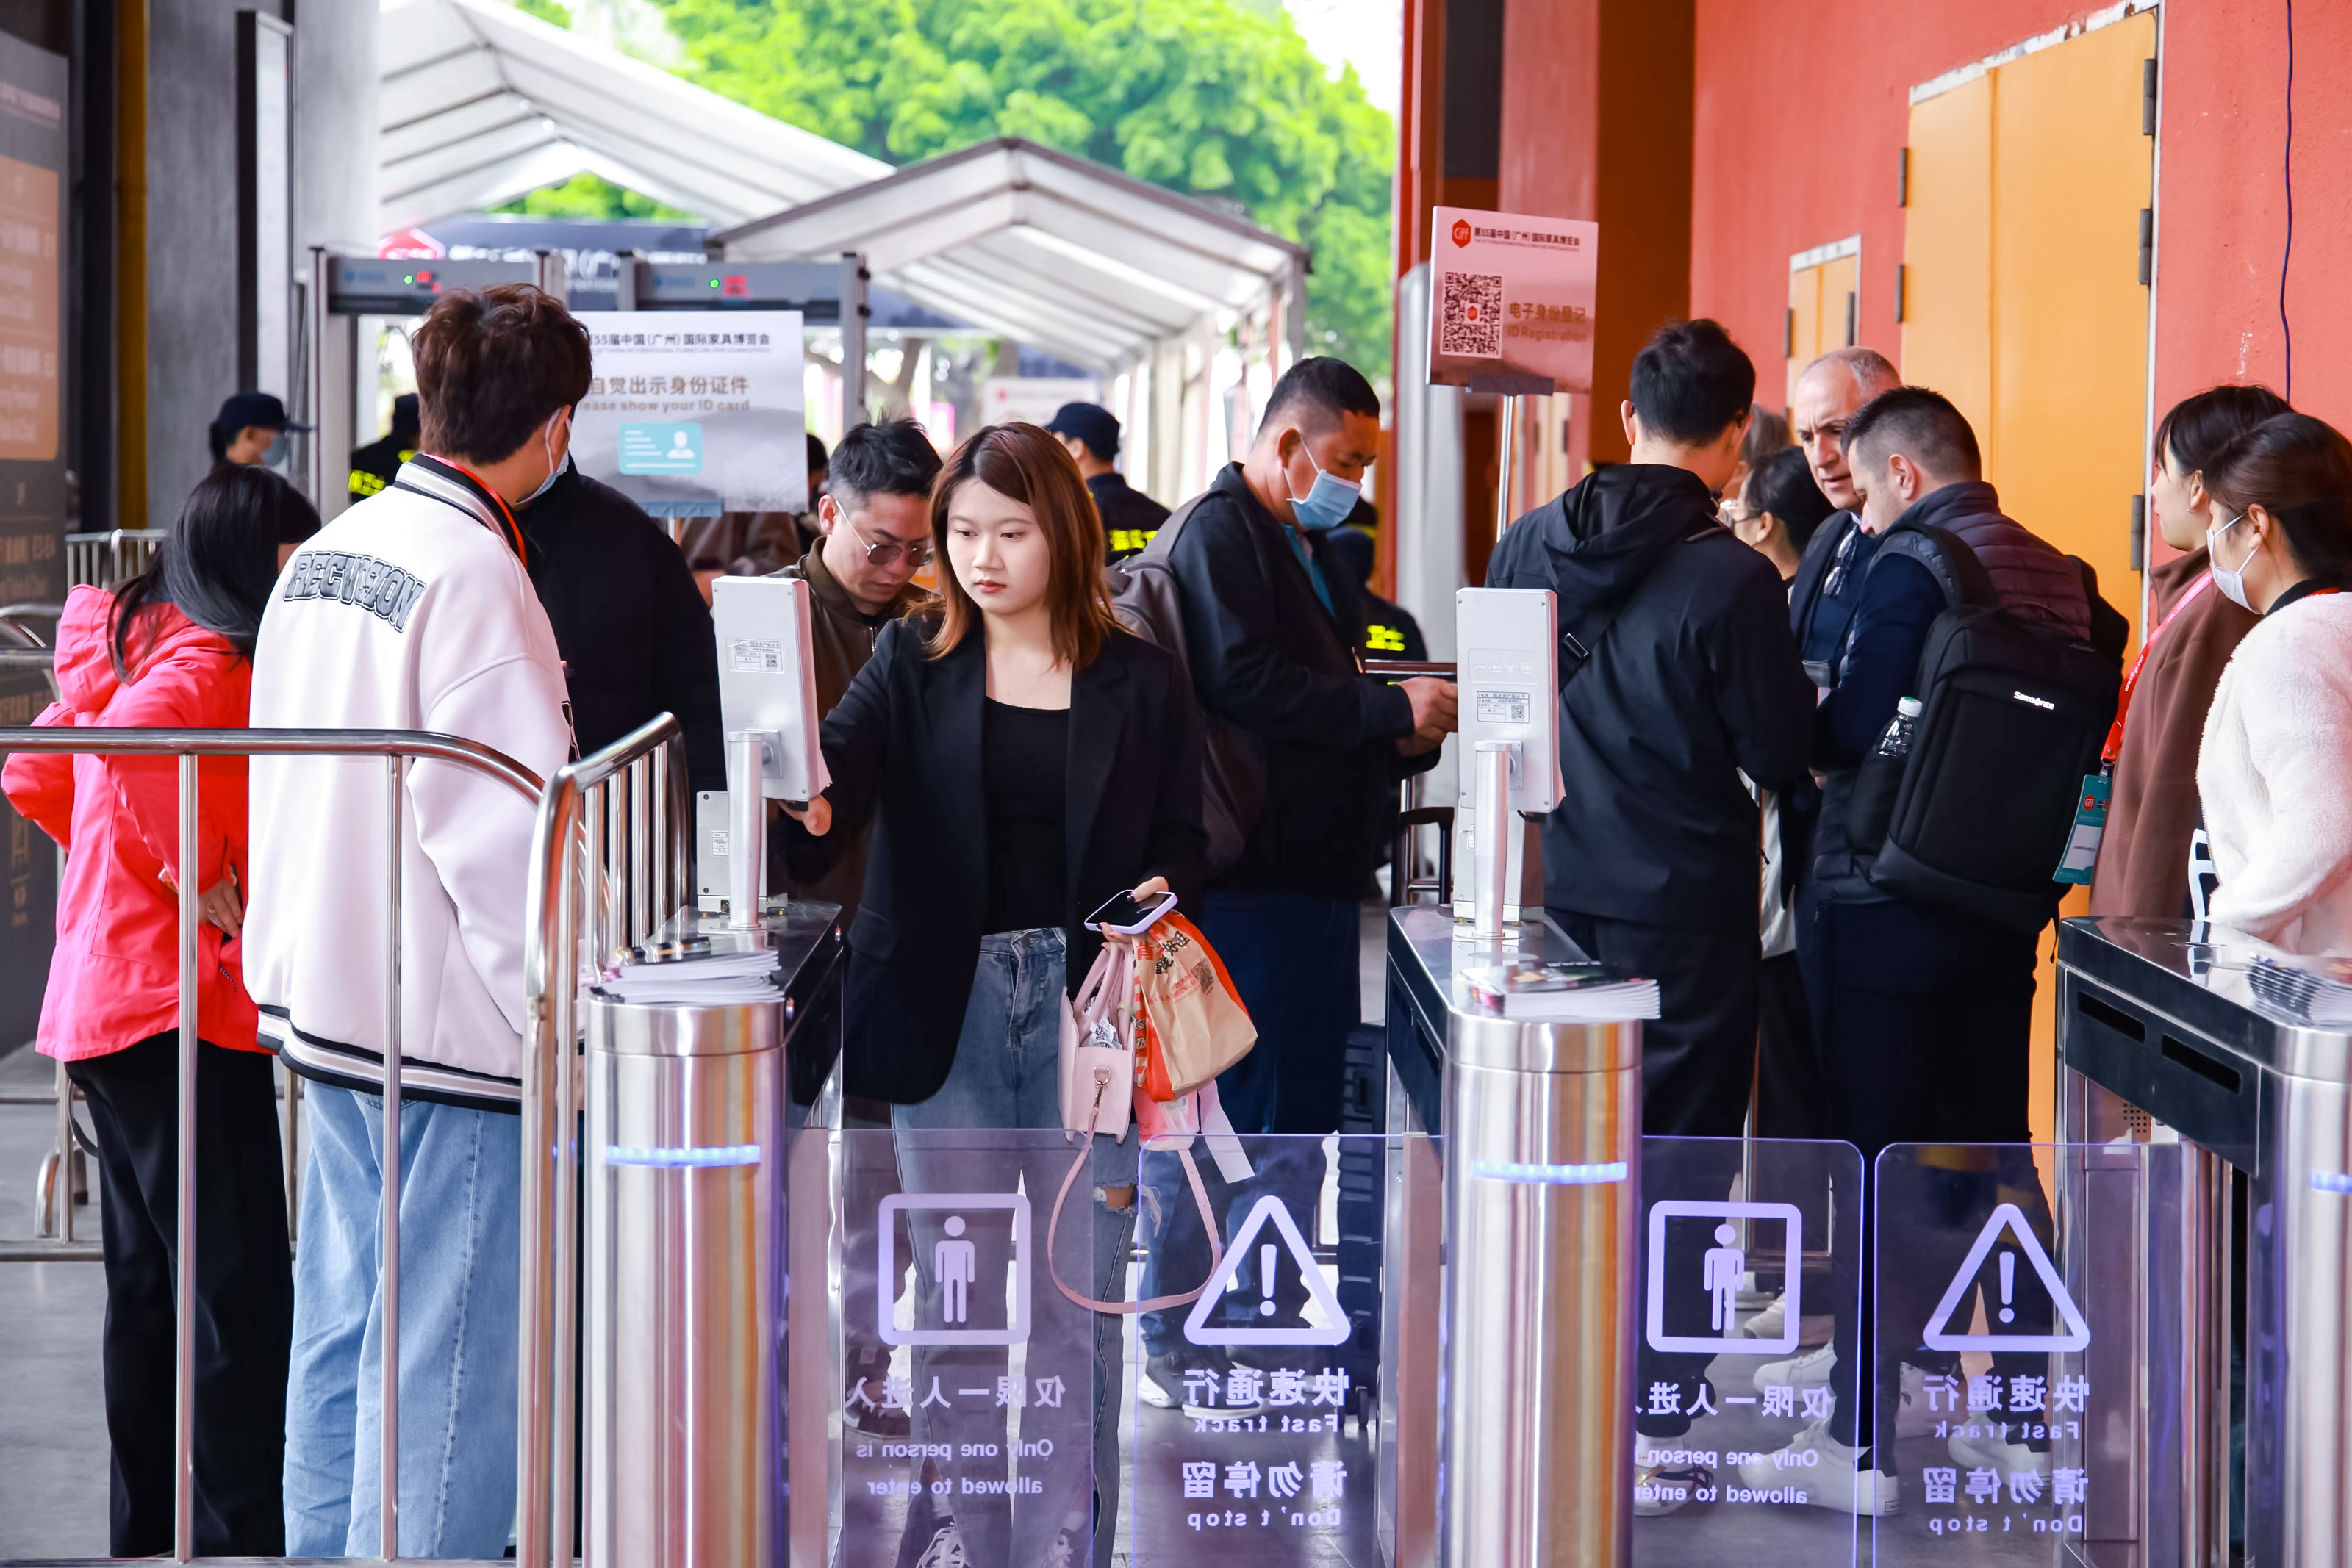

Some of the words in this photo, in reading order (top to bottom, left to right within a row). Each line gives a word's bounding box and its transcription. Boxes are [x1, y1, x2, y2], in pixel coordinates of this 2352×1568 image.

[1509, 302, 1587, 323] 电子身份登记
[589, 333, 770, 346] 55届中国（广州）国际家具博览会
[1521, 326, 1587, 342] Registration
[579, 400, 616, 411] lease
[621, 400, 658, 411] show
[662, 401, 695, 414] your
[698, 399, 714, 411] ID
[717, 400, 750, 411] card
